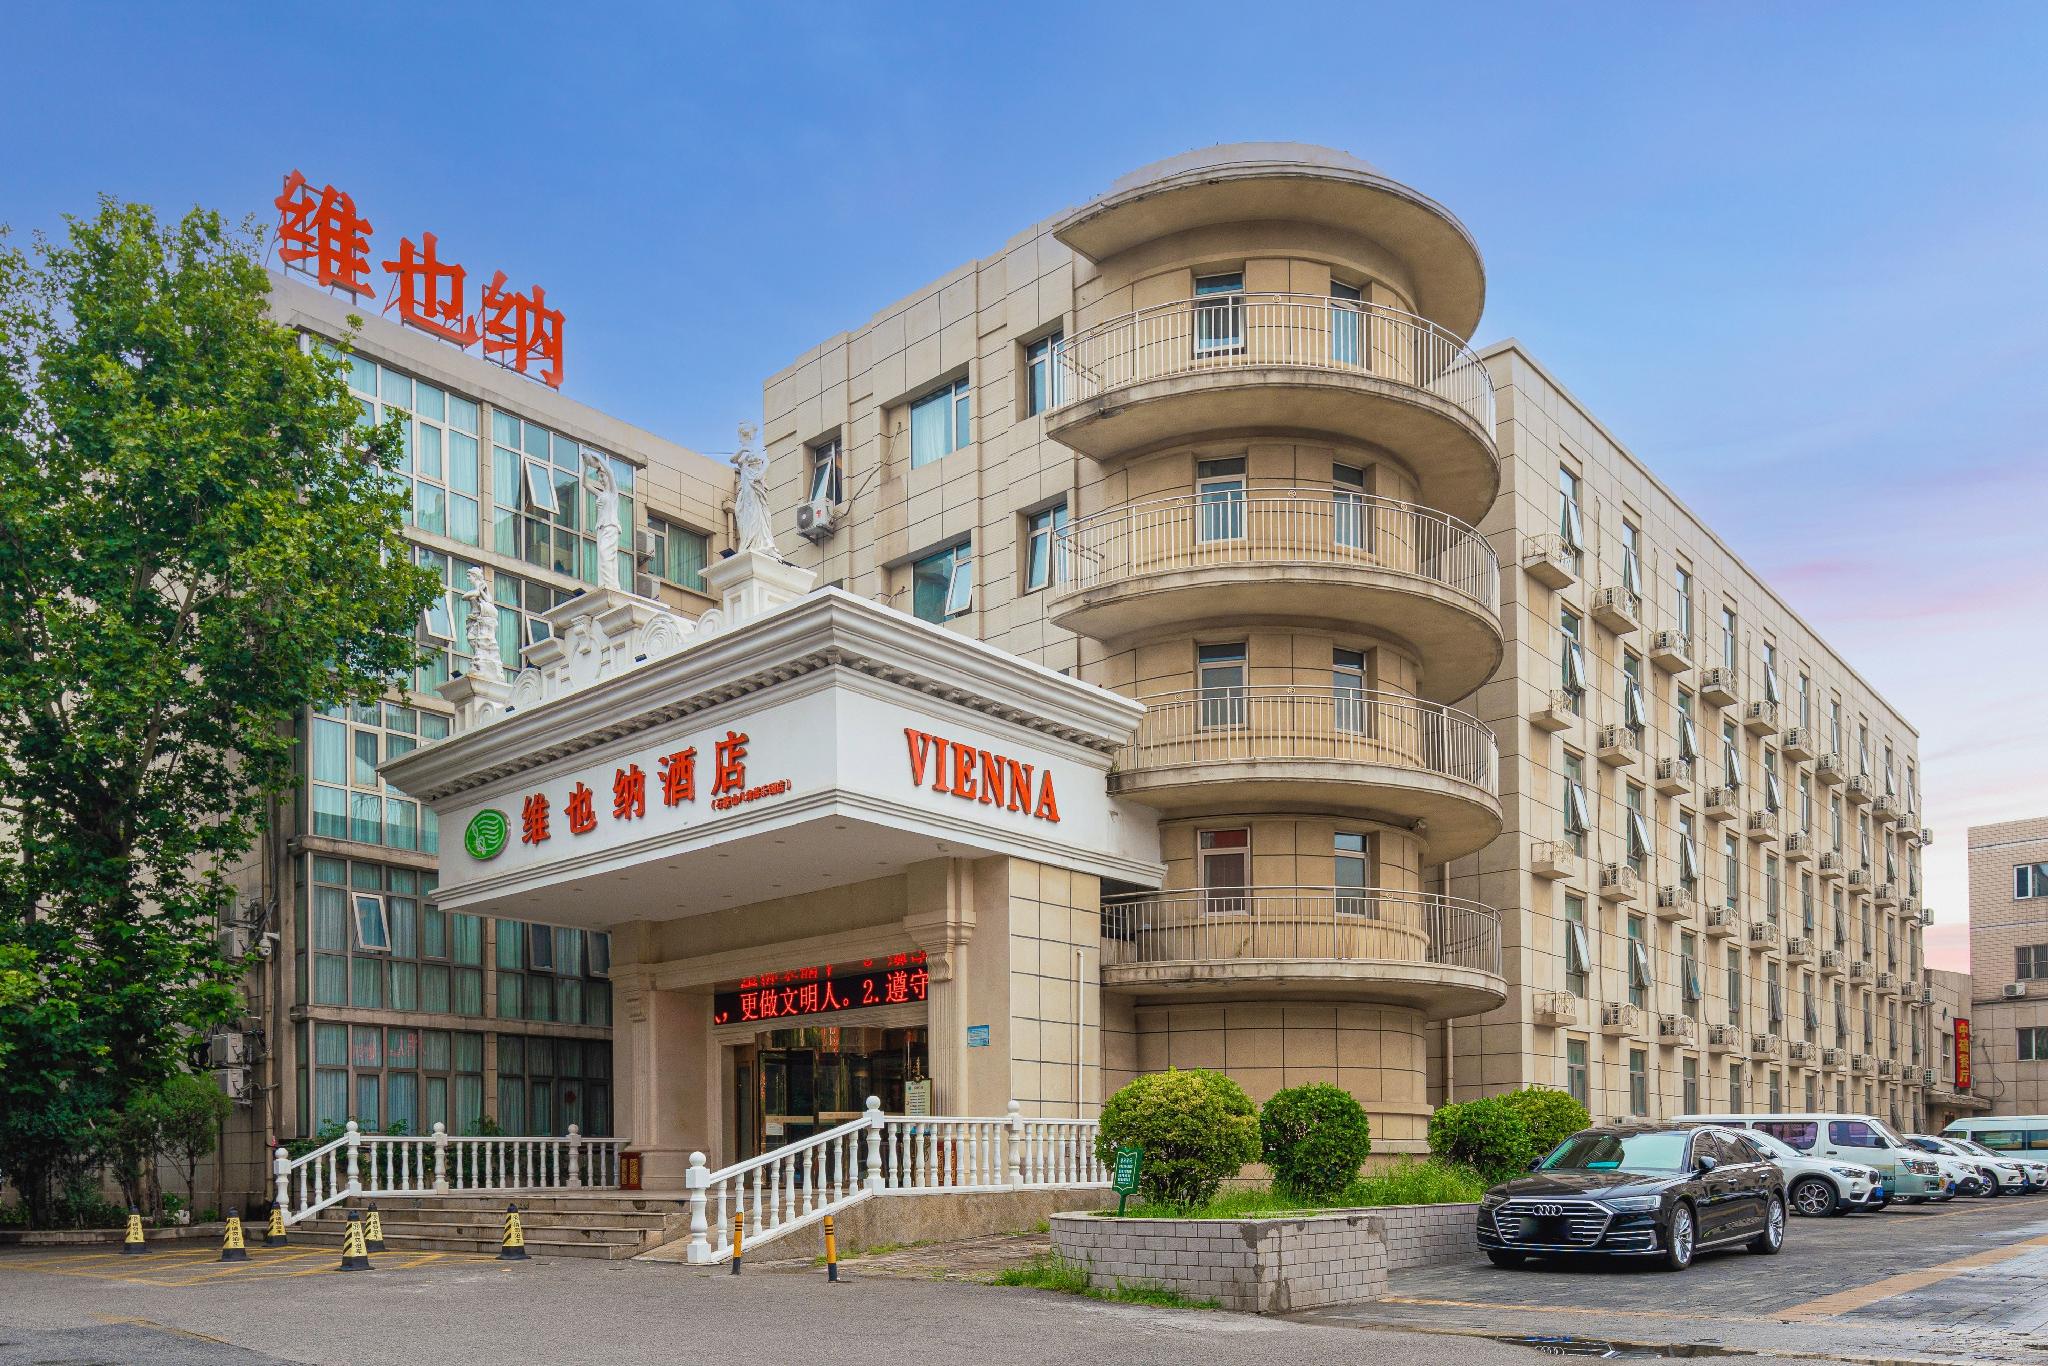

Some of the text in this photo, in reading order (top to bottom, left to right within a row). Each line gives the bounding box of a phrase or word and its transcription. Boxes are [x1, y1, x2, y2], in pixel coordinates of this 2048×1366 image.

[274, 168, 566, 388] 维也纳
[521, 730, 749, 845] 维也纳酒店
[904, 728, 1061, 823] VIENNA
